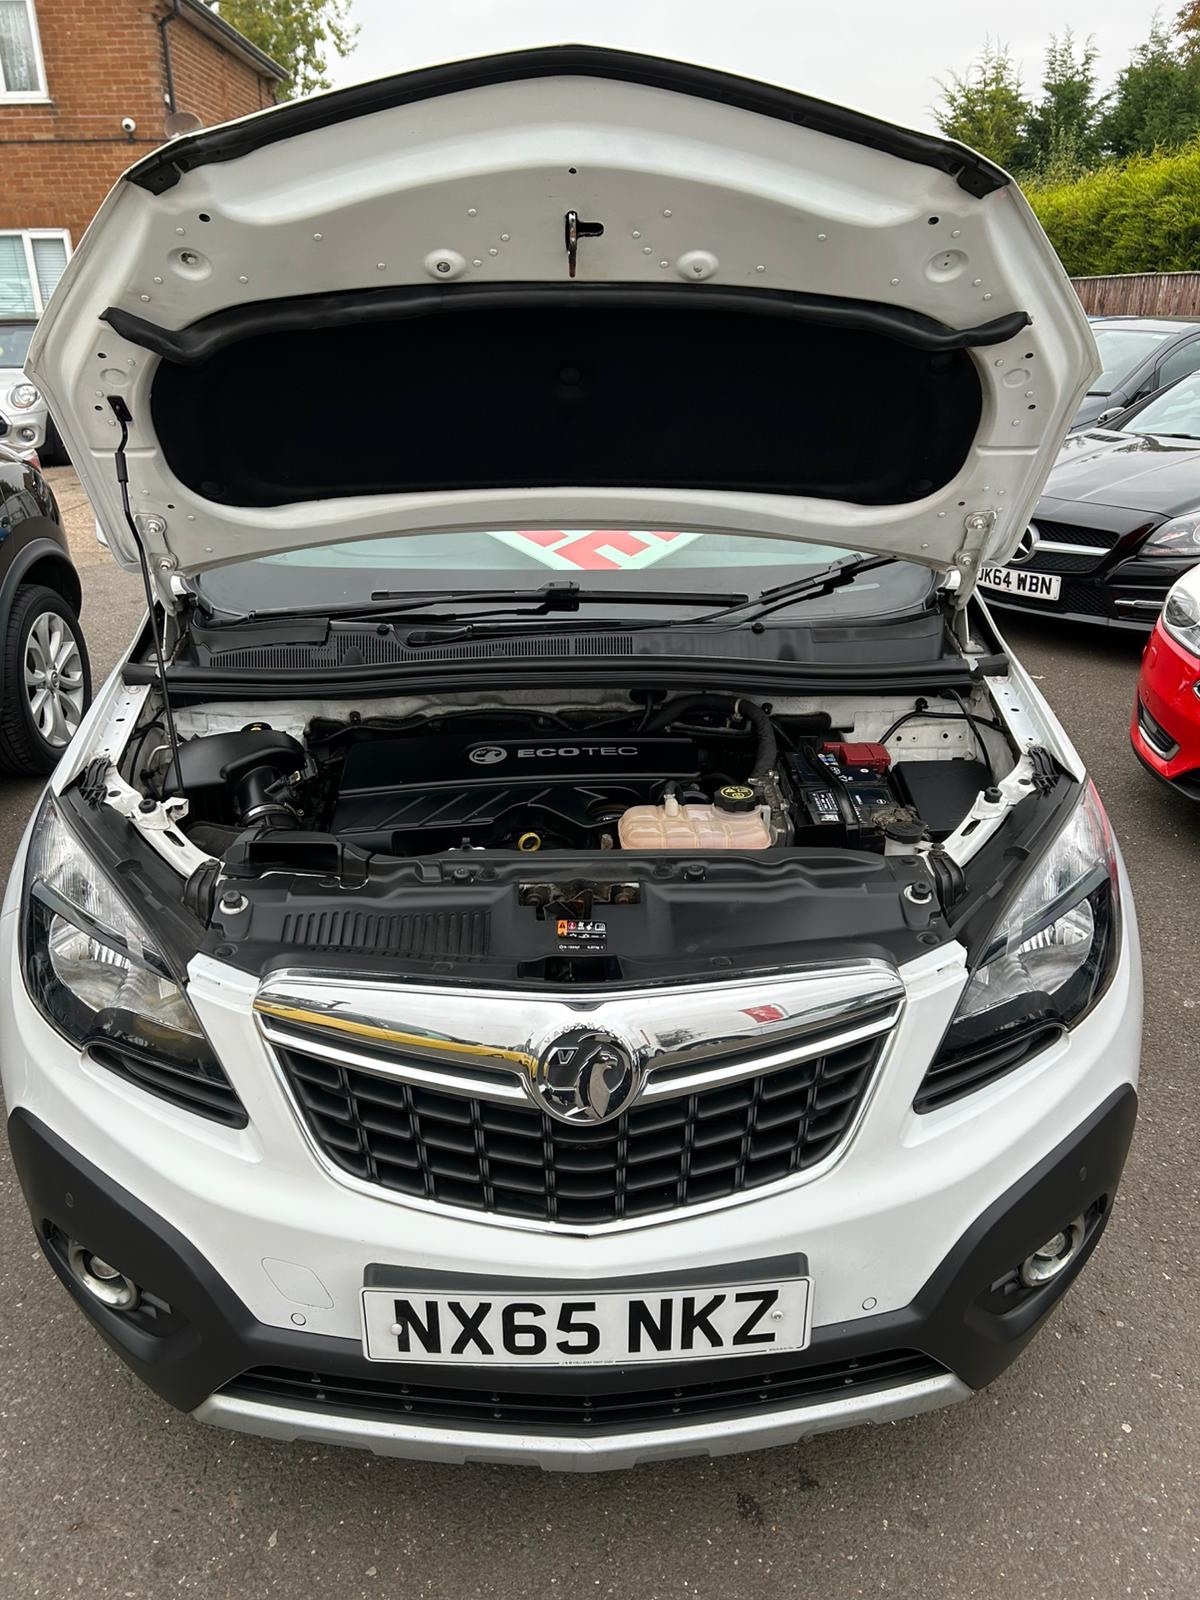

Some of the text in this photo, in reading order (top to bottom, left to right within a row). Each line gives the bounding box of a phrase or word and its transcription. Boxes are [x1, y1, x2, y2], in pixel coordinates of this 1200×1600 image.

[1017, 573, 1053, 595] WBN
[517, 747, 639, 758] ECOTEC
[393, 1289, 780, 1356] NX65 NKZ
